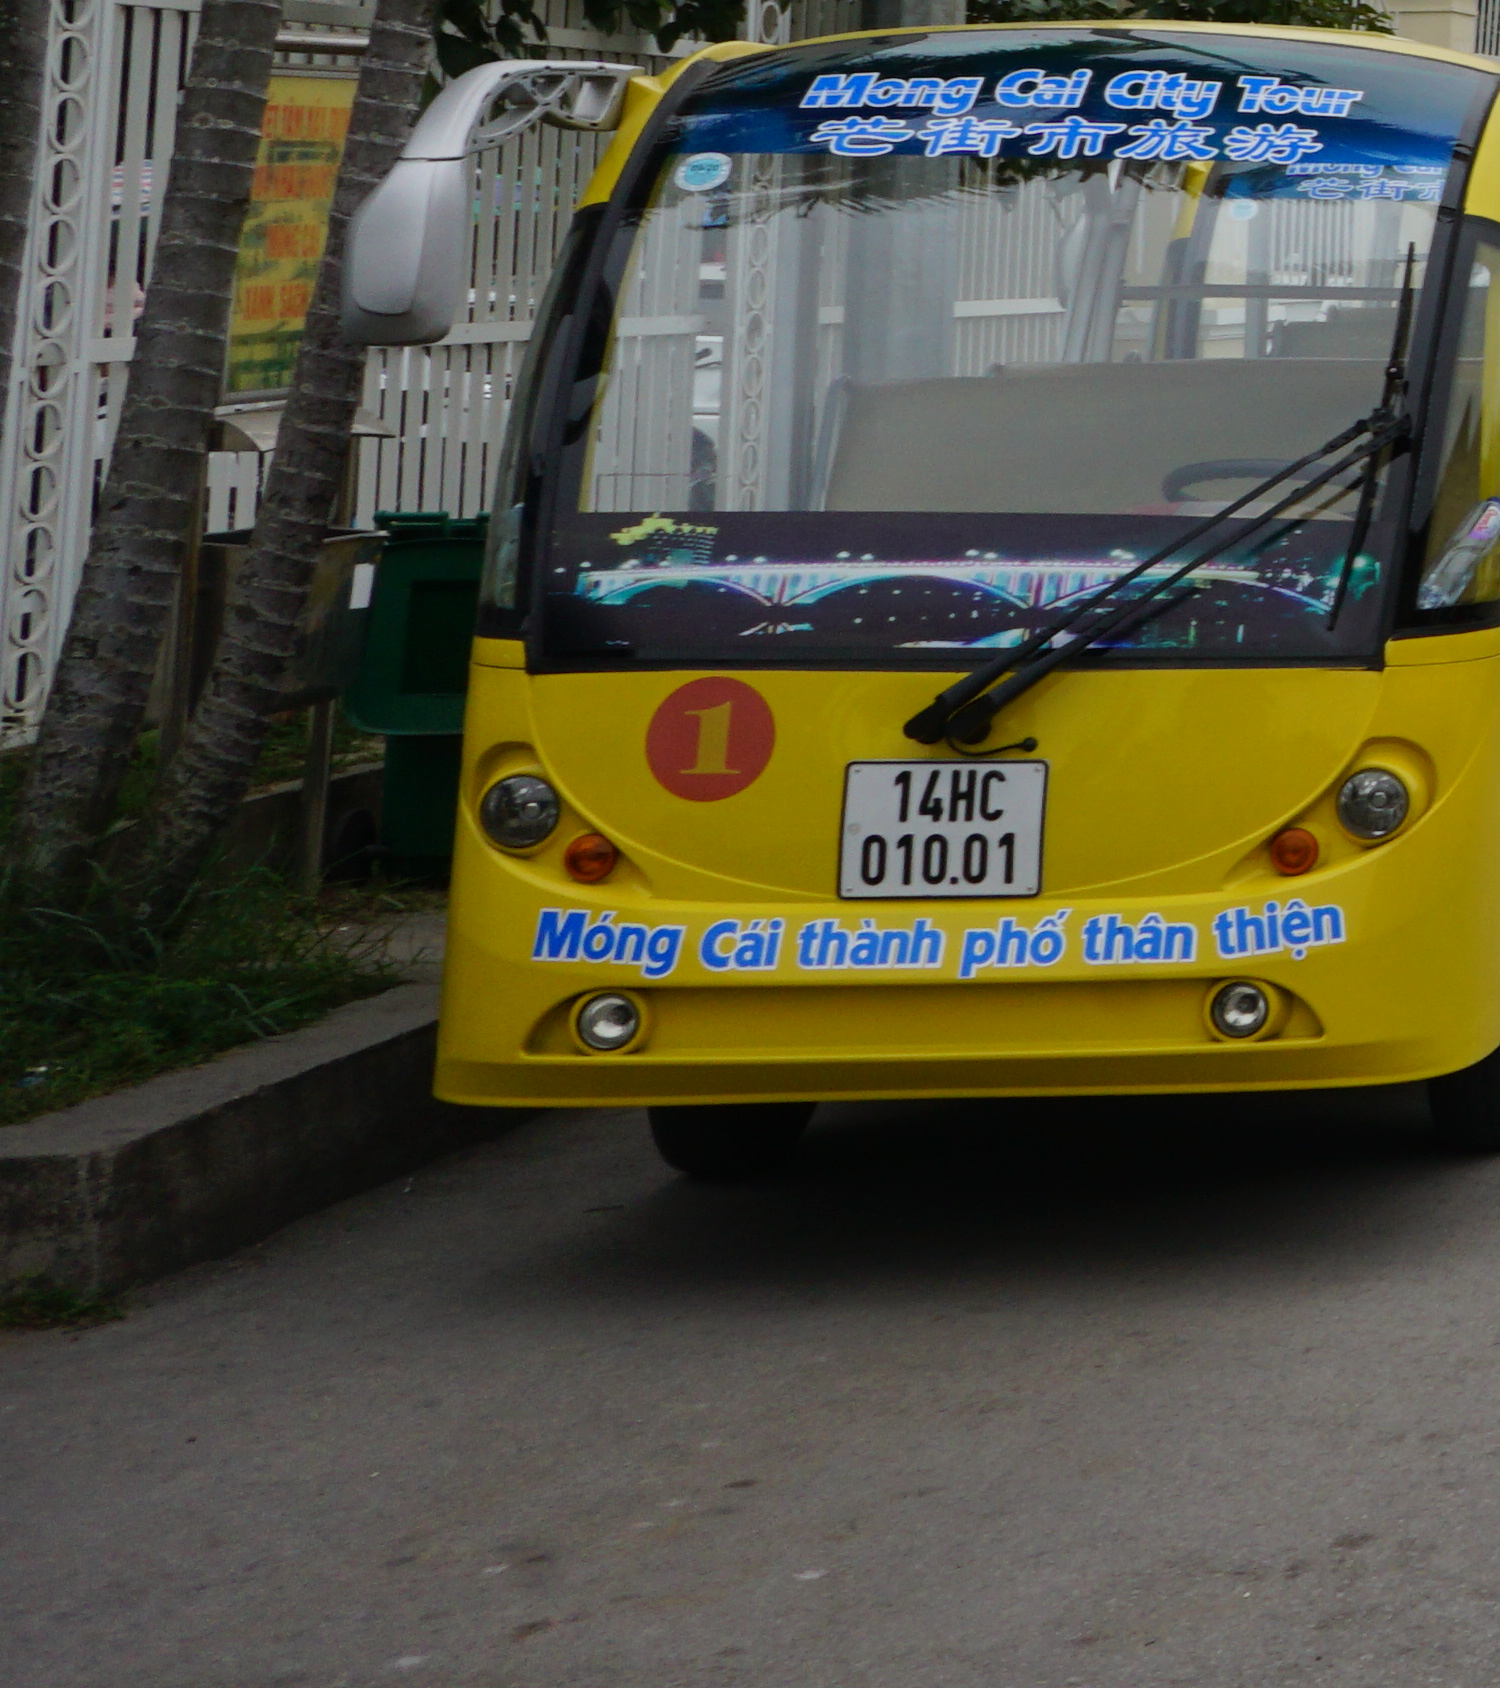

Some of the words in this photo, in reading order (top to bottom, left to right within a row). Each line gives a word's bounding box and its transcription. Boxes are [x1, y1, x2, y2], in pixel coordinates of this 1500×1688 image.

[800, 71, 980, 116] Mong
[995, 68, 1094, 109] Cai
[1104, 69, 1222, 119] City
[1238, 75, 1365, 118] Tour
[811, 114, 1324, 163] 芒街市旅游
[679, 700, 740, 775] 1
[894, 769, 1007, 823] 14HC
[860, 831, 1016, 886] 010.01
[532, 907, 687, 979] Móng
[698, 917, 785, 971] Cái
[797, 917, 946, 969] thành
[957, 908, 1073, 979] phố
[1082, 912, 1198, 966] thân
[1212, 898, 1347, 960] thiện
